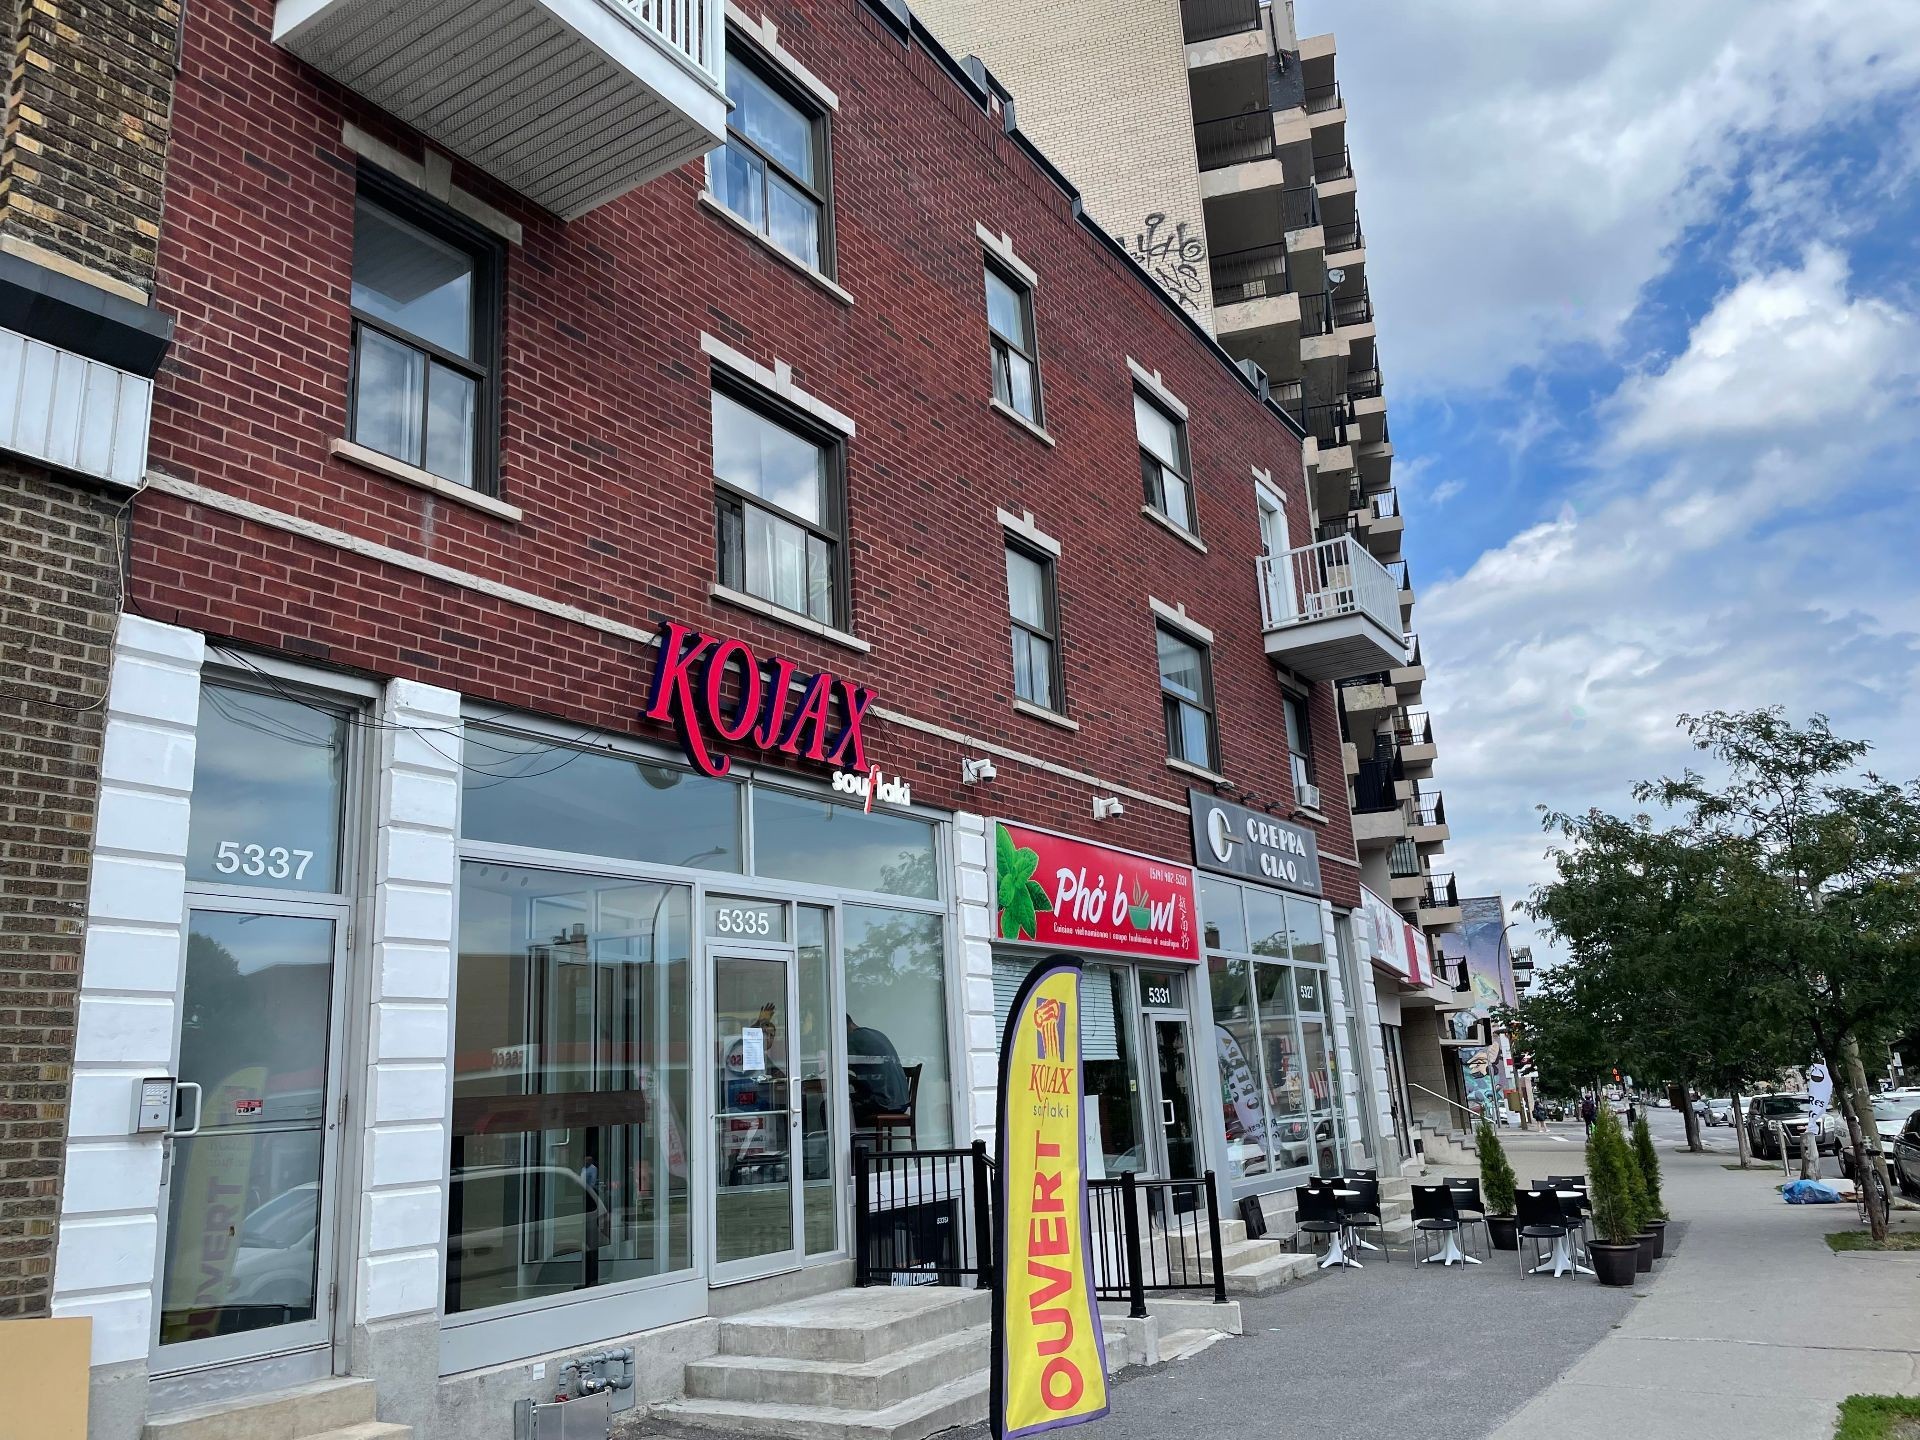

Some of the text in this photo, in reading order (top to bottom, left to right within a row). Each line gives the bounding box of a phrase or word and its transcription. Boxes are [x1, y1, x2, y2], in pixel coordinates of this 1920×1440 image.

[642, 621, 878, 777] KOJAX
[1246, 818, 1307, 857] CREPPA
[215, 840, 314, 881] 5337
[1260, 852, 1297, 883] CIAO
[718, 908, 770, 935] 5335
[1148, 987, 1171, 1004] 5331
[1300, 985, 1314, 999] 5327
[1028, 1063, 1074, 1103] KOJAX
[1027, 1129, 1085, 1412] OUVERT
